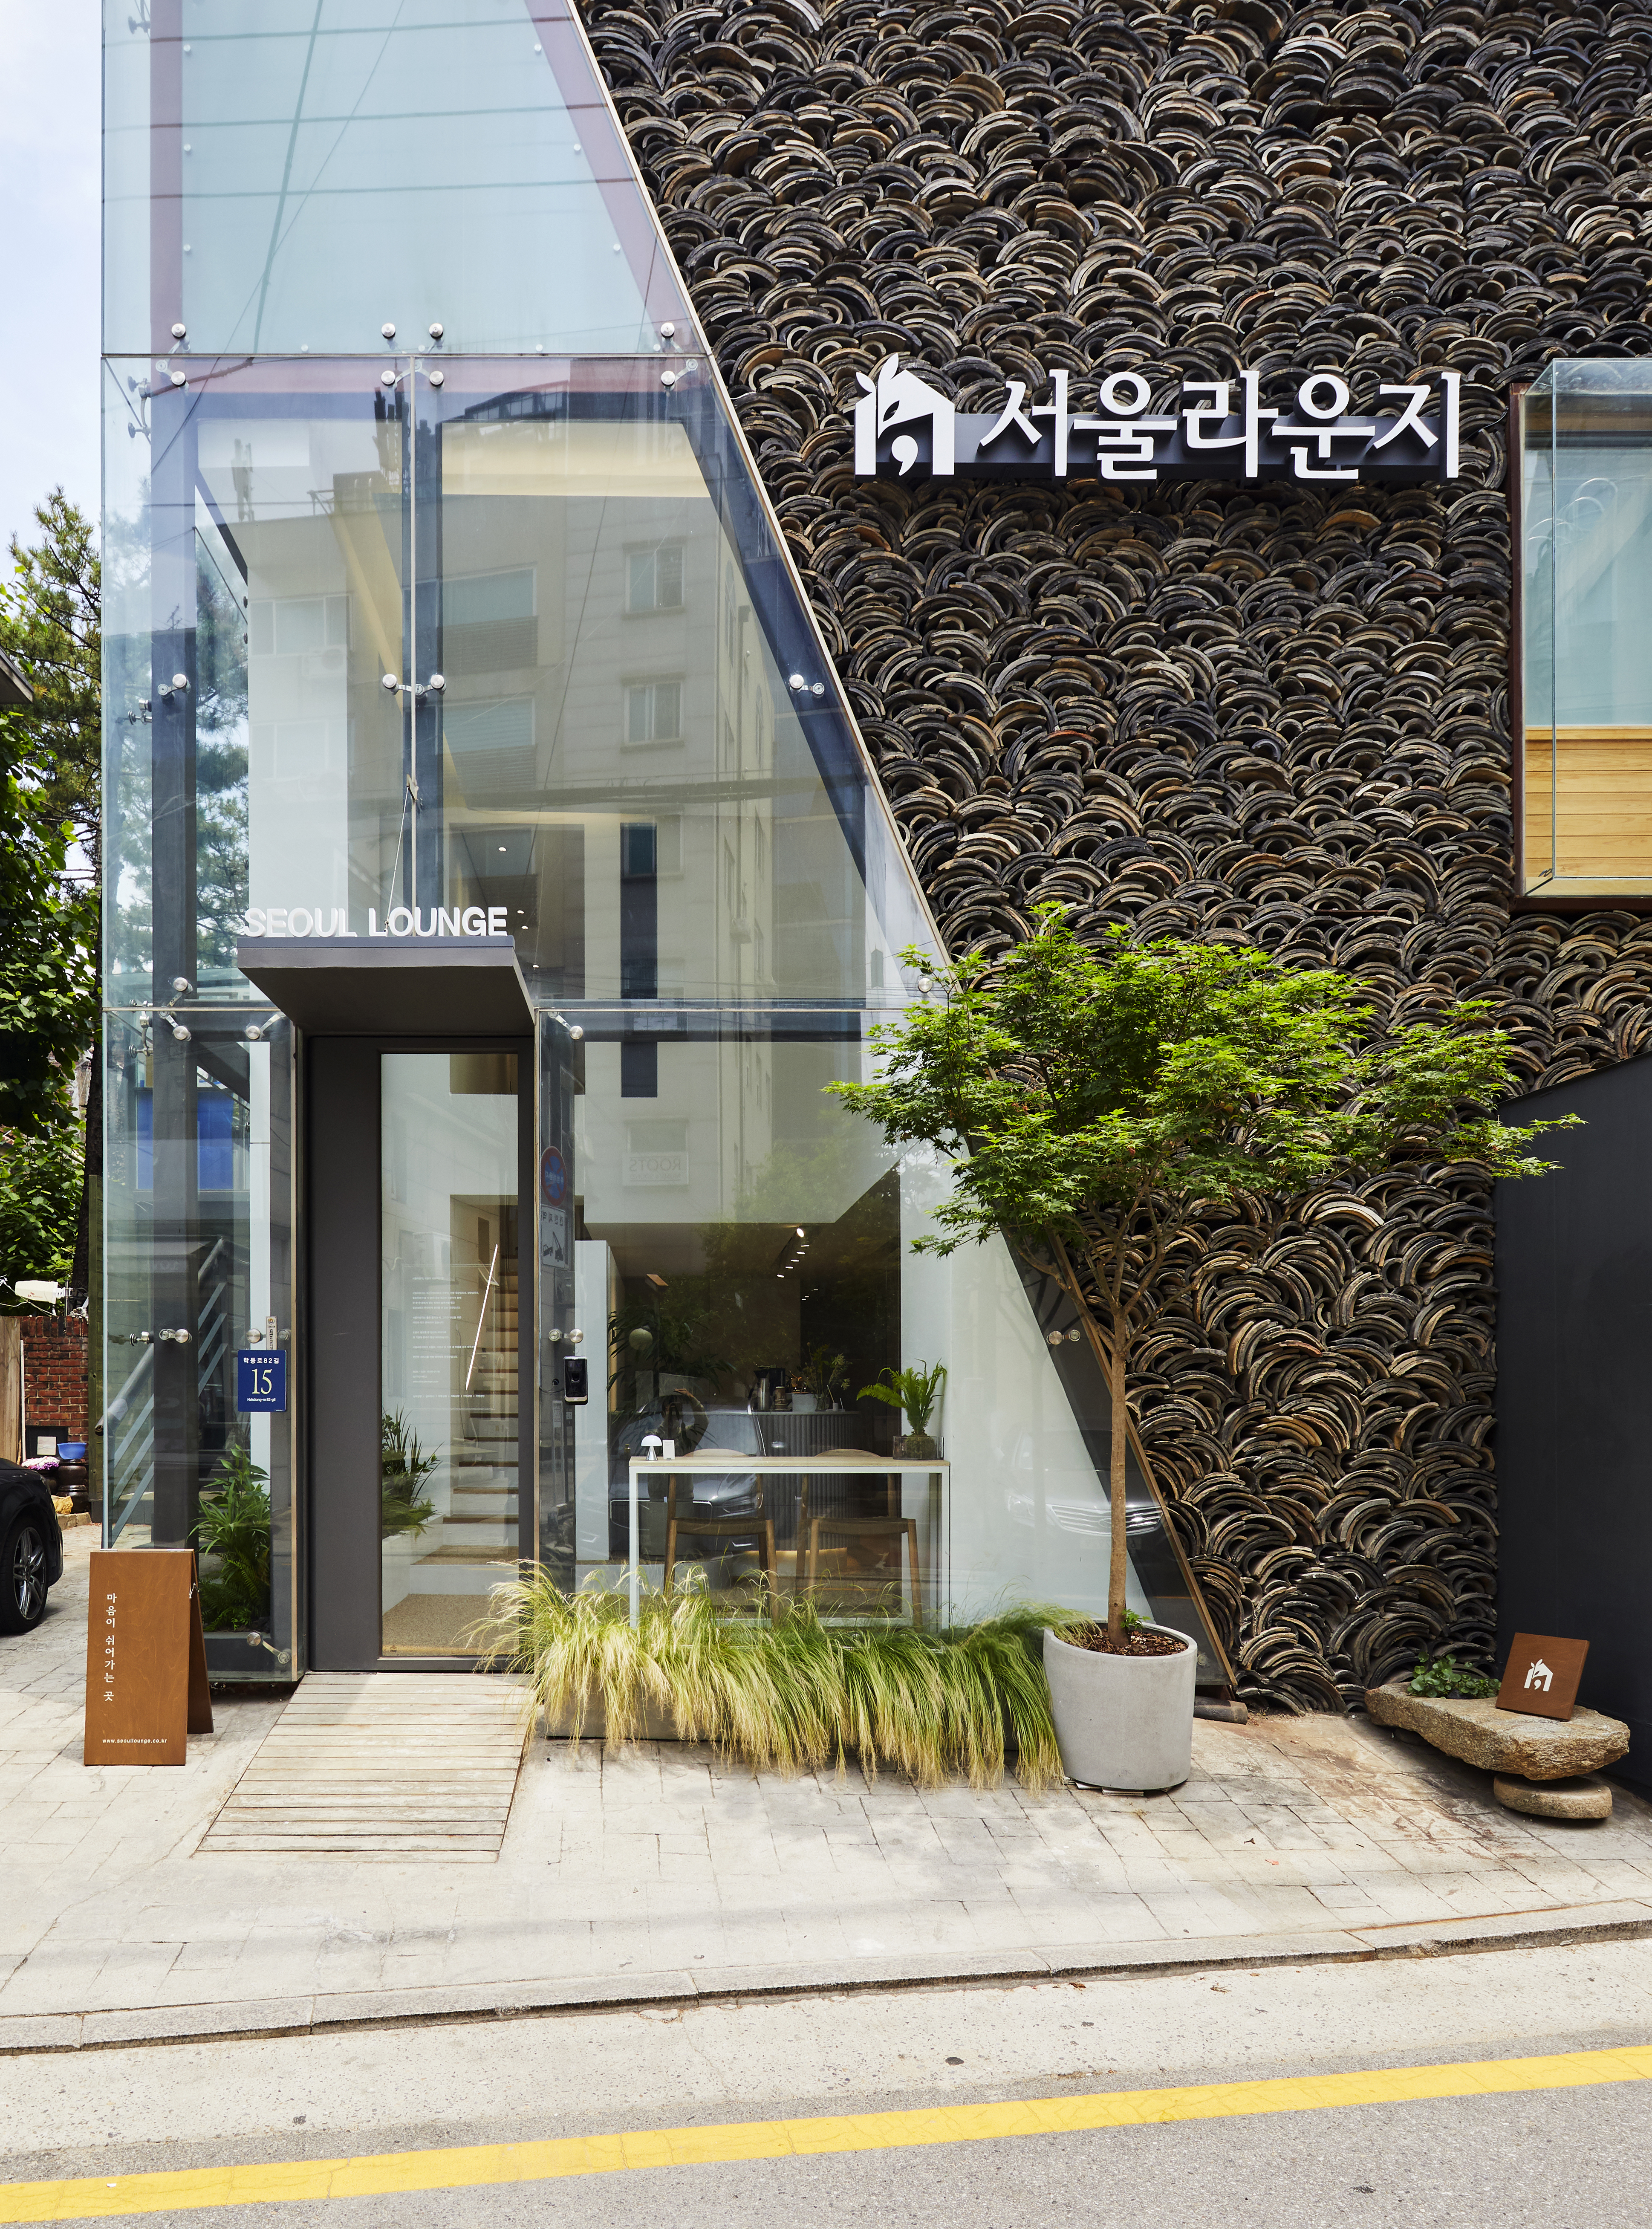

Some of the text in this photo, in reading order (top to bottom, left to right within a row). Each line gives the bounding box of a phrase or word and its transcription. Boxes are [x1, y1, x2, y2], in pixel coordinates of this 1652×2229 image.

[979, 369, 1459, 480] 서울라운지
[244, 907, 508, 937] SEOUL LOUNGE
[251, 1368, 272, 1394] 15
[103, 1593, 117, 1702] 마음이 쉬어가는 곳
